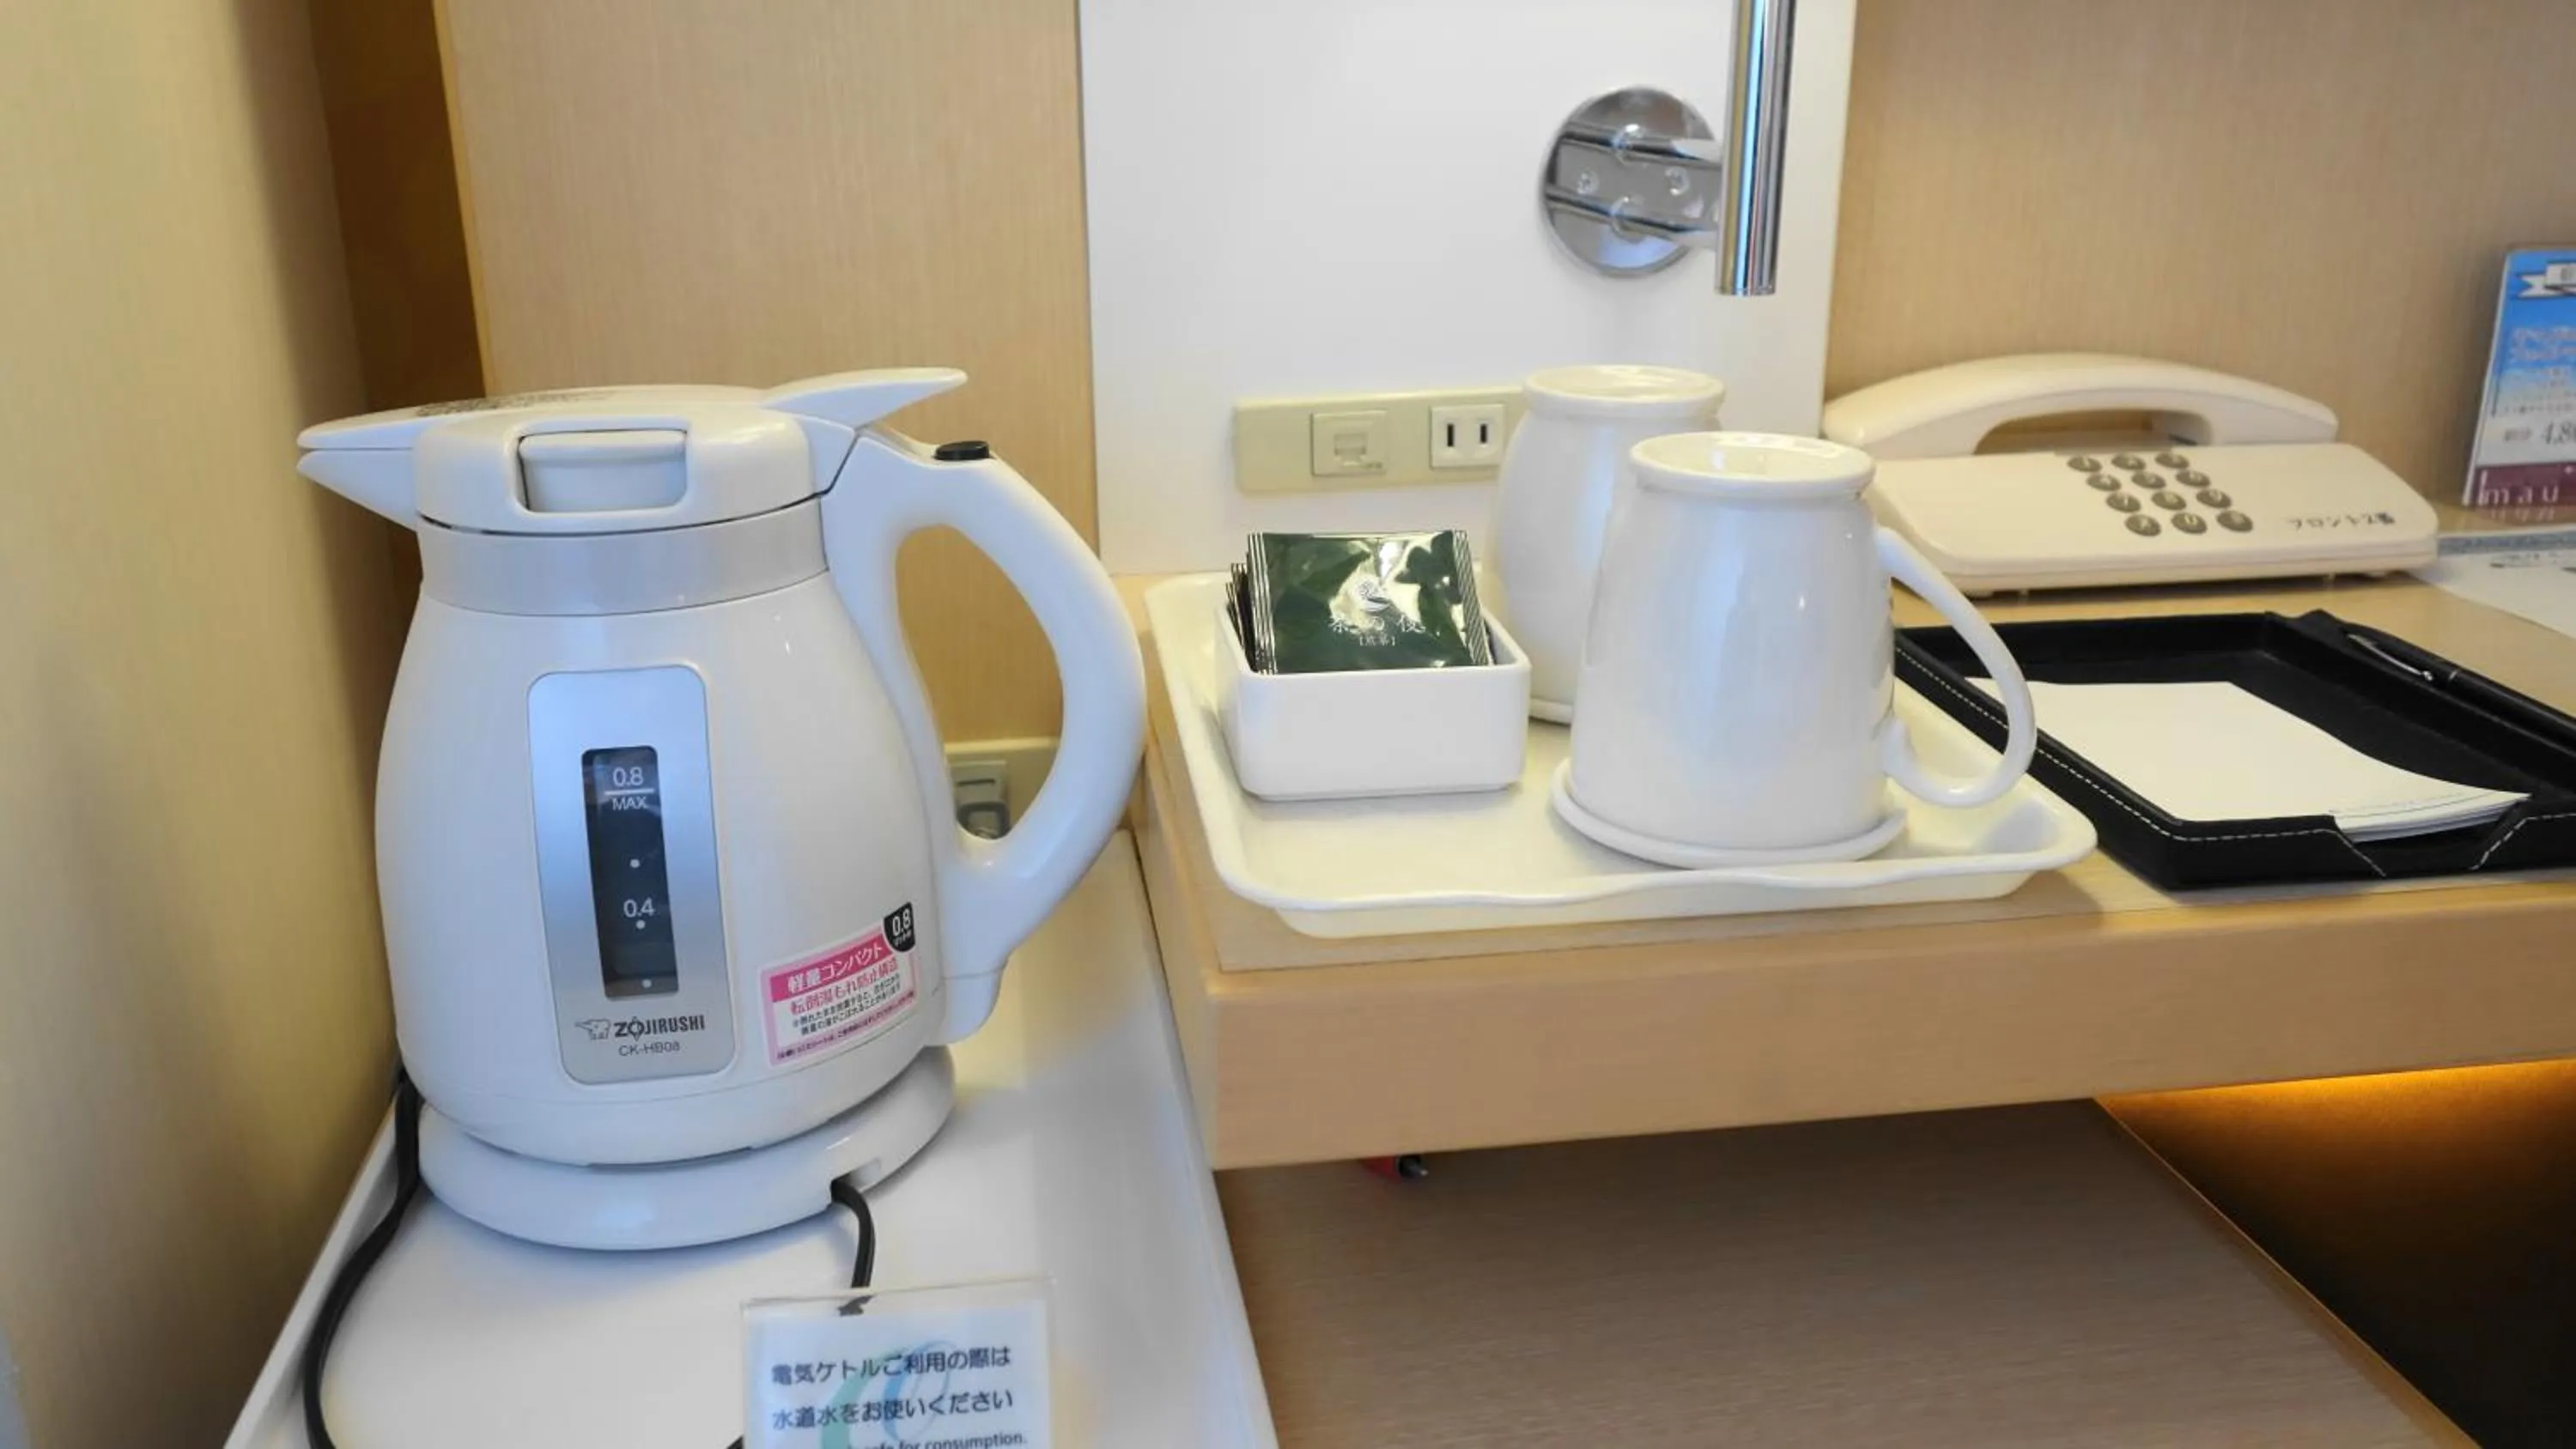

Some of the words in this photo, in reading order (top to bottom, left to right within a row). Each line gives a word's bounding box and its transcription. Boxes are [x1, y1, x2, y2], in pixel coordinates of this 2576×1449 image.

[612, 767, 644, 787] 0.8
[612, 796, 647, 809] MAX
[623, 898, 655, 918] 0.4
[892, 908, 911, 937] 0.8
[614, 1015, 705, 1042] ZOJIRUSHI
[772, 1345, 1012, 1385] 電気ケトルご利用の際は
[773, 1390, 1013, 1429] 水道水をお使いください
